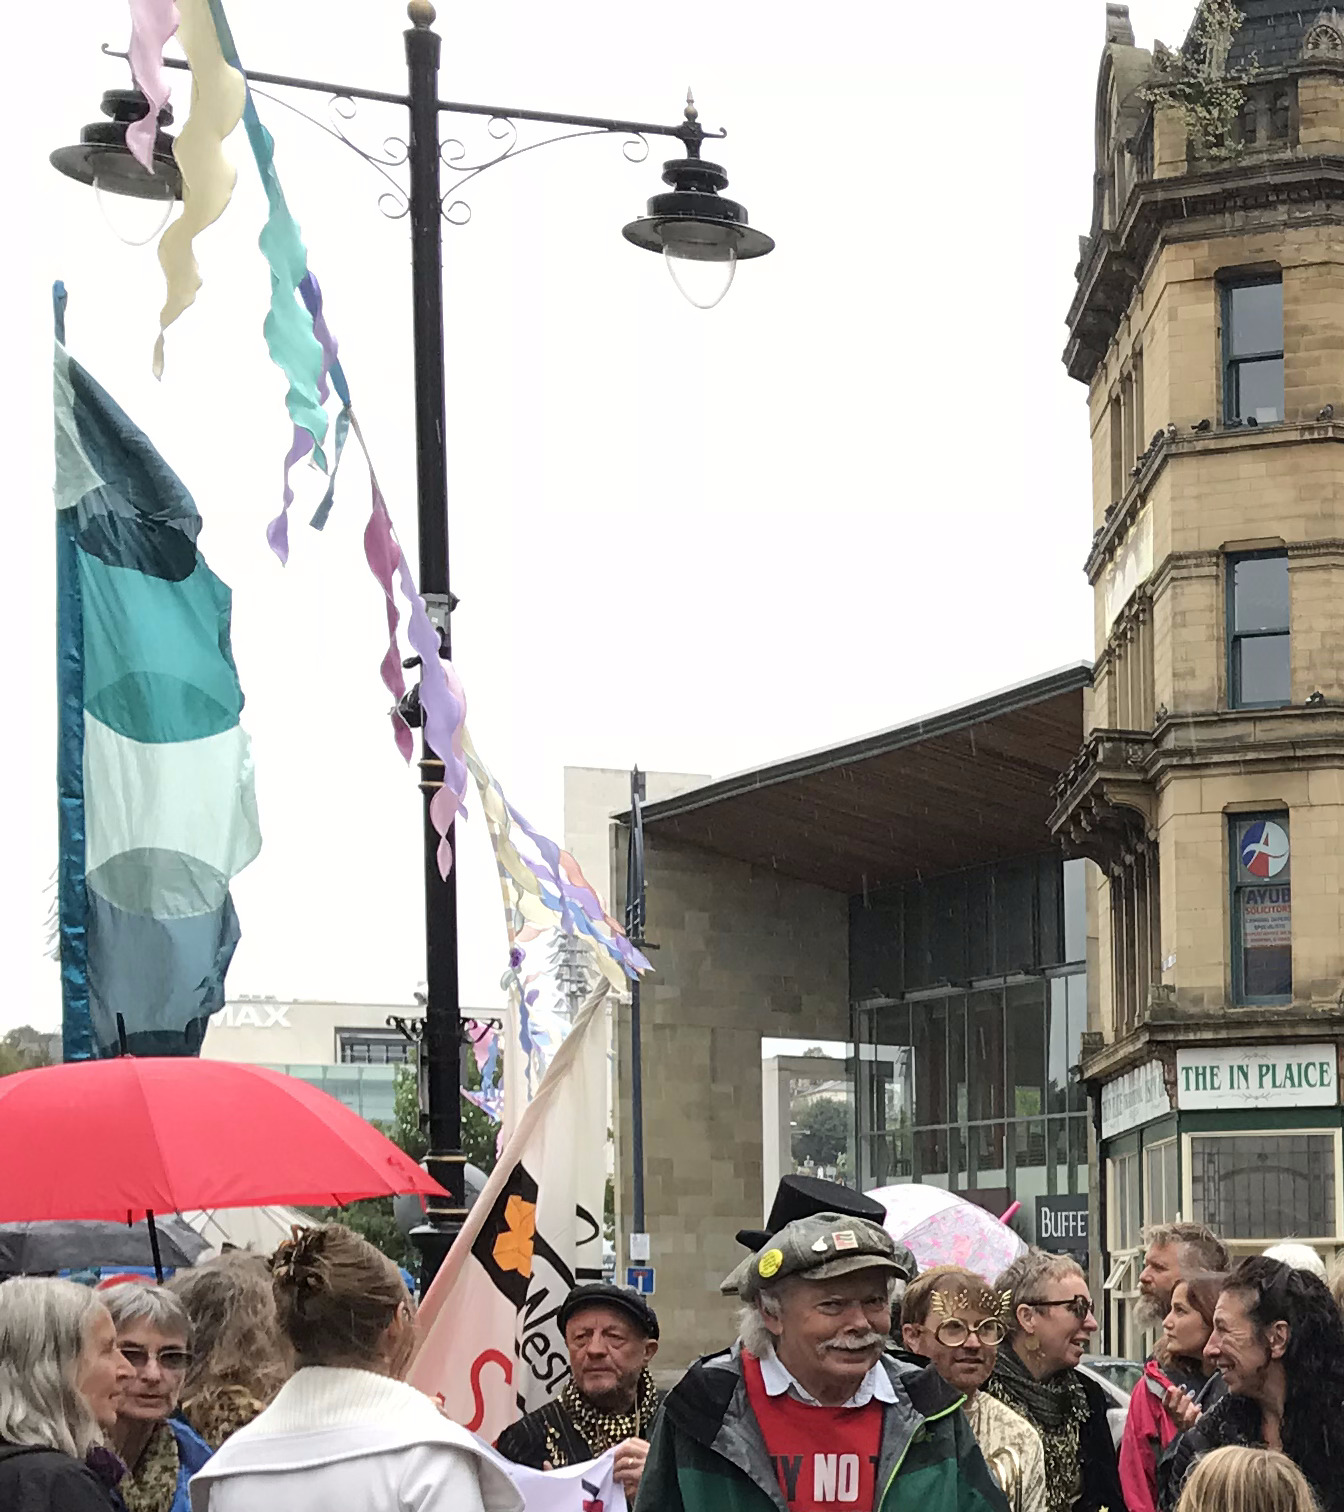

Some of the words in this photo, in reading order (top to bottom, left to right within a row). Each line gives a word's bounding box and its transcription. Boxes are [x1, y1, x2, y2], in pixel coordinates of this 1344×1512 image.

[1181, 1065, 1221, 1092] THE
[1228, 1064, 1250, 1090] IN
[1258, 1061, 1332, 1089] PLAICE
[813, 1453, 860, 1502] NO
